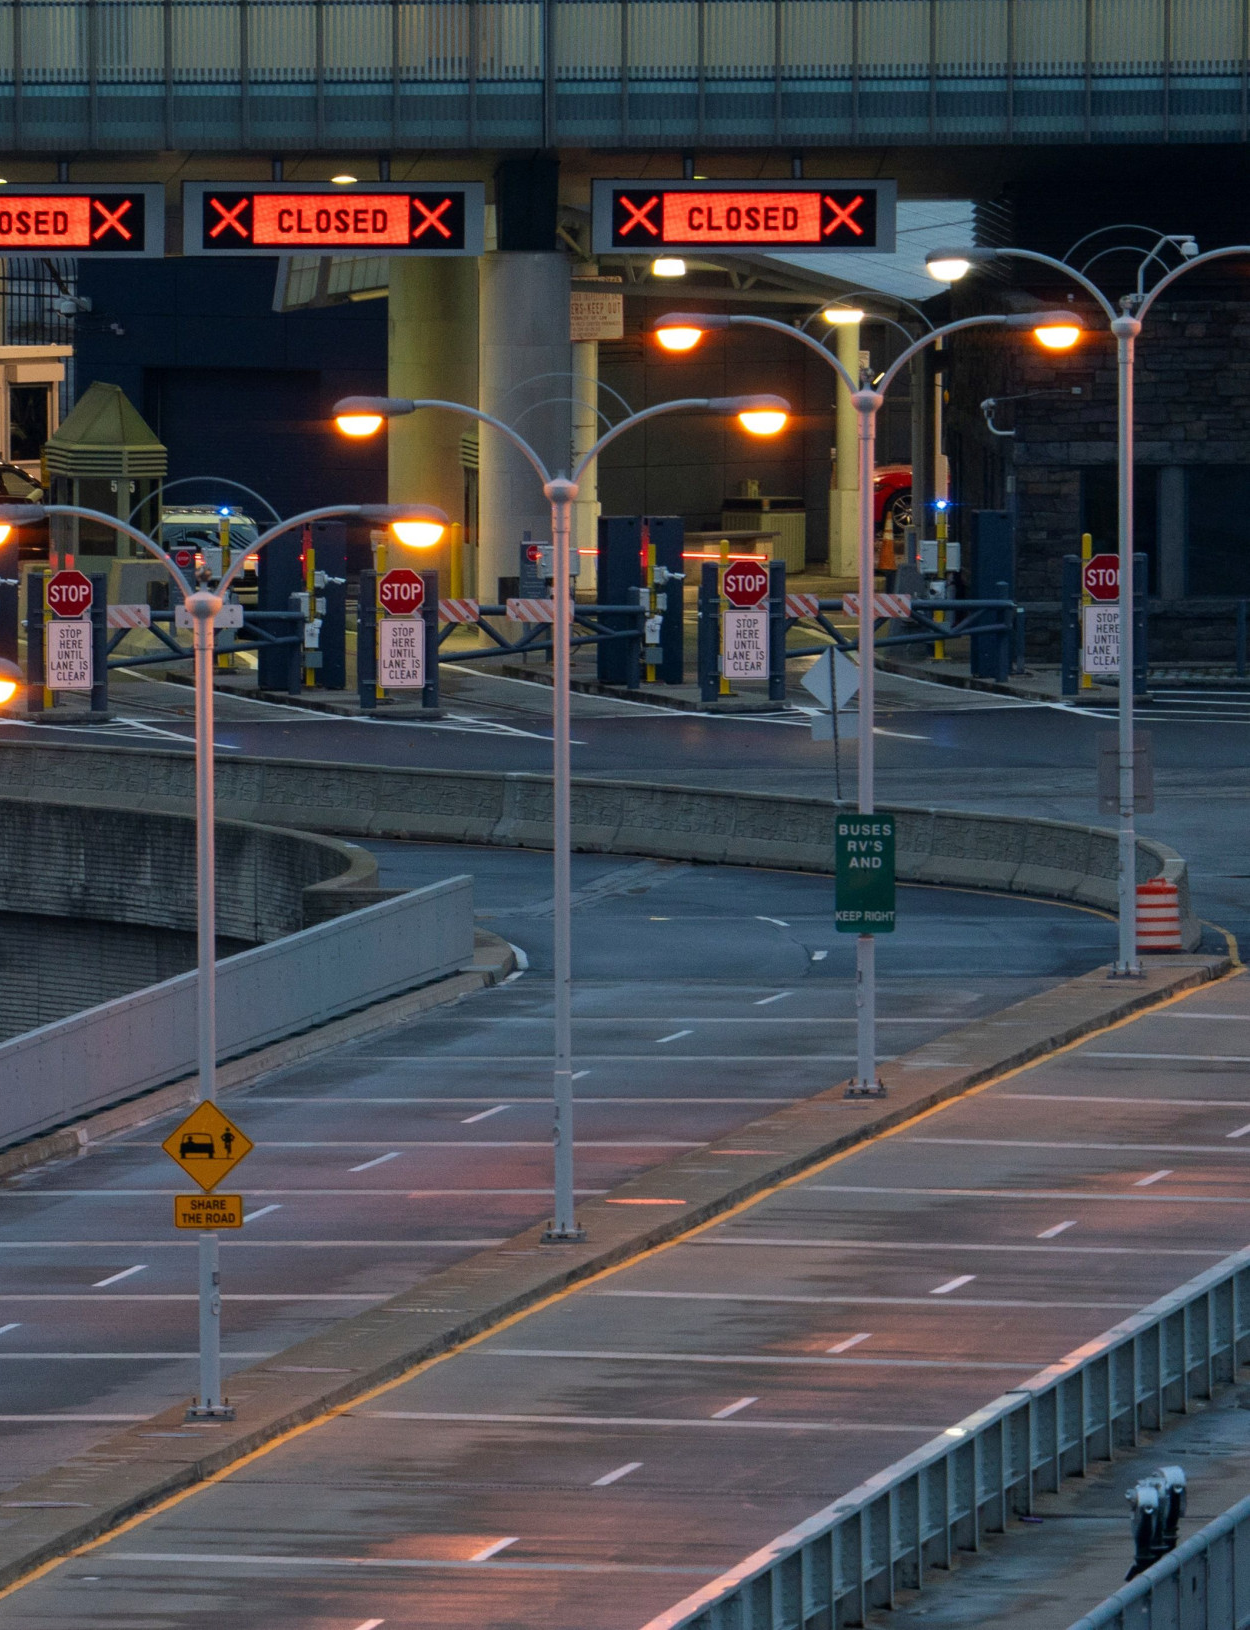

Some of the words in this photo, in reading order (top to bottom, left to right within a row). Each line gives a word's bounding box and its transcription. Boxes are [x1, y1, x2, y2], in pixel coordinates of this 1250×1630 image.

[278, 209, 388, 233] CLOSED
[688, 207, 798, 231] CLOSED
[110, 480, 118, 493] 5
[129, 480, 136, 493] 5
[1086, 569, 1120, 586] STO
[726, 575, 766, 592] STOP
[50, 585, 89, 602] STOP
[382, 583, 422, 600] STOP
[736, 619, 758, 628] STOP
[59, 629, 82, 639] STOP
[392, 627, 414, 637] STOP
[736, 630, 759, 639] HERE
[59, 640, 83, 649] HERE
[392, 638, 415, 647] HERE
[734, 641, 760, 650] UNTIL
[57, 651, 84, 660] UNTIL
[390, 649, 416, 658] UNTIL
[727, 651, 750, 660] LANE
[756, 651, 765, 660] IS
[1087, 646, 1111, 655] LANE
[50, 661, 74, 670] LANE
[79, 661, 88, 670] IS
[383, 660, 406, 669] LANE
[412, 660, 421, 669] IS
[733, 662, 762, 671] CLEAR
[57, 672, 85, 681] CLEAR
[389, 670, 418, 680] CLEAR
[838, 824, 892, 836] BUSES
[847, 840, 883, 852] RV'S
[849, 857, 882, 868] AND
[835, 911, 862, 921] KEEP
[864, 911, 895, 921] RIGHT
[190, 1200, 226, 1210] SHARE
[182, 1213, 202, 1223] THE
[205, 1213, 236, 1223] ROAD
